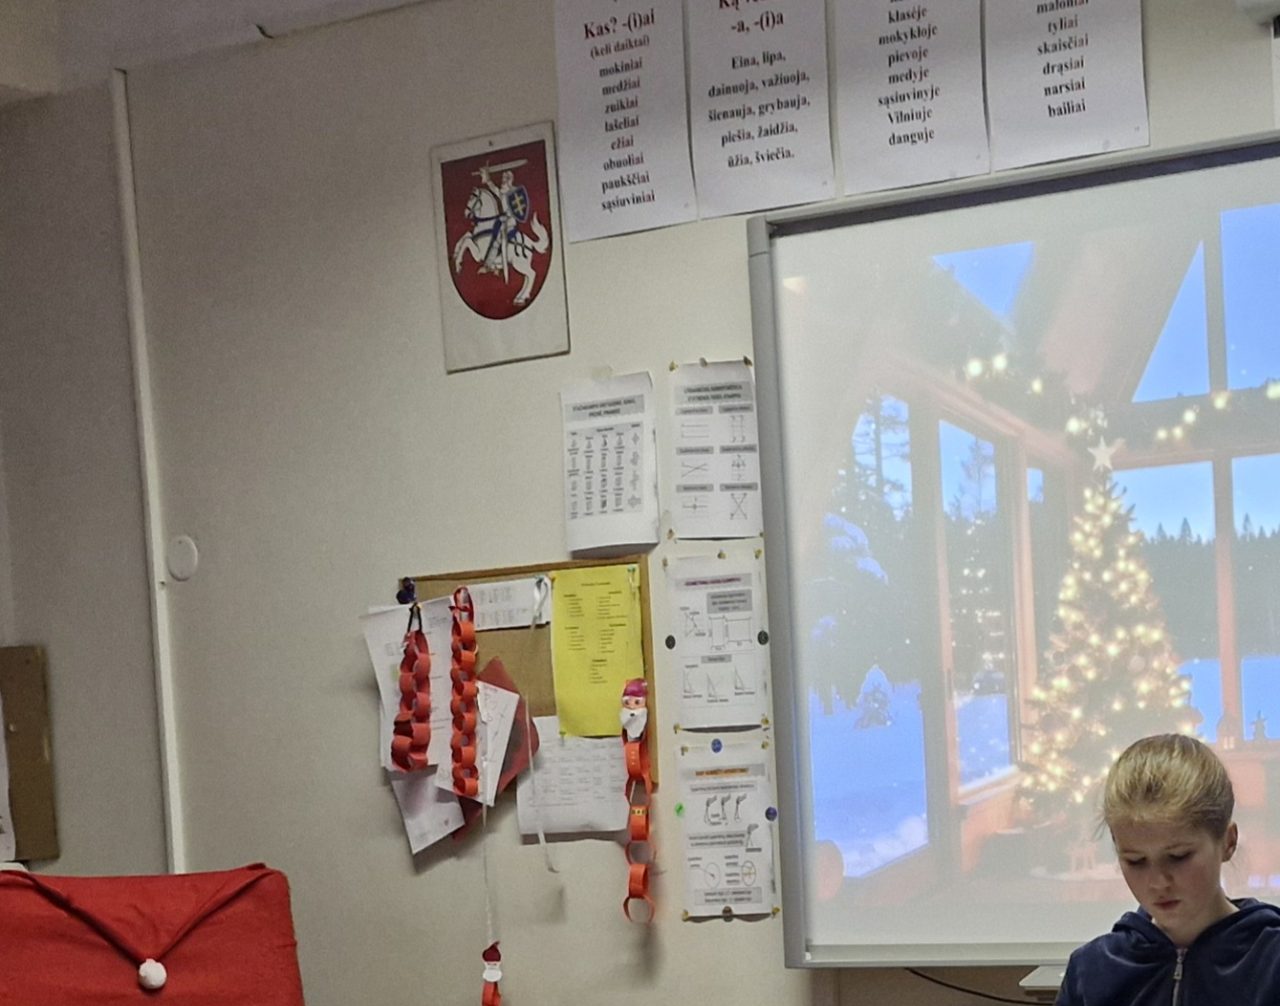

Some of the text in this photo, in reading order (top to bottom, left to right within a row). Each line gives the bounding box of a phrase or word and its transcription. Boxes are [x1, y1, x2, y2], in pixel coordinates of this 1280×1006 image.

[584, 8, 654, 39] Kas? -(i)ai
[731, 10, 784, 32] -a, -(i)a
[888, 5, 927, 23] klasėje
[879, 24, 938, 45] mokykloje
[1047, 14, 1079, 35] tyliai
[590, 35, 650, 60] (keli daiktai)
[1037, 33, 1089, 56] skaisčiai
[732, 51, 786, 69] Eina, lipa,
[888, 45, 928, 68] pievoje
[1042, 55, 1084, 76] drąsiai
[600, 57, 642, 77] mokiniai
[888, 66, 929, 84] medyje
[602, 76, 640, 95] medžiai
[708, 69, 810, 98] dainuoja, važiuoja,
[1044, 76, 1085, 96] narsiai
[605, 96, 638, 114] zuikiai
[878, 84, 940, 109] sąsiuvinyje
[708, 94, 810, 122] šienauja, grybauja,
[888, 106, 933, 124] Vilniuje
[1047, 98, 1086, 118] bailiai
[605, 115, 639, 132] lašeliai
[757, 121, 798, 138] žaidžia,
[611, 134, 634, 150] ežiai
[888, 127, 935, 146] danguje
[603, 151, 644, 171] obuoliai
[602, 171, 650, 194] paukščiai
[602, 189, 655, 213] sąsiuviniai
